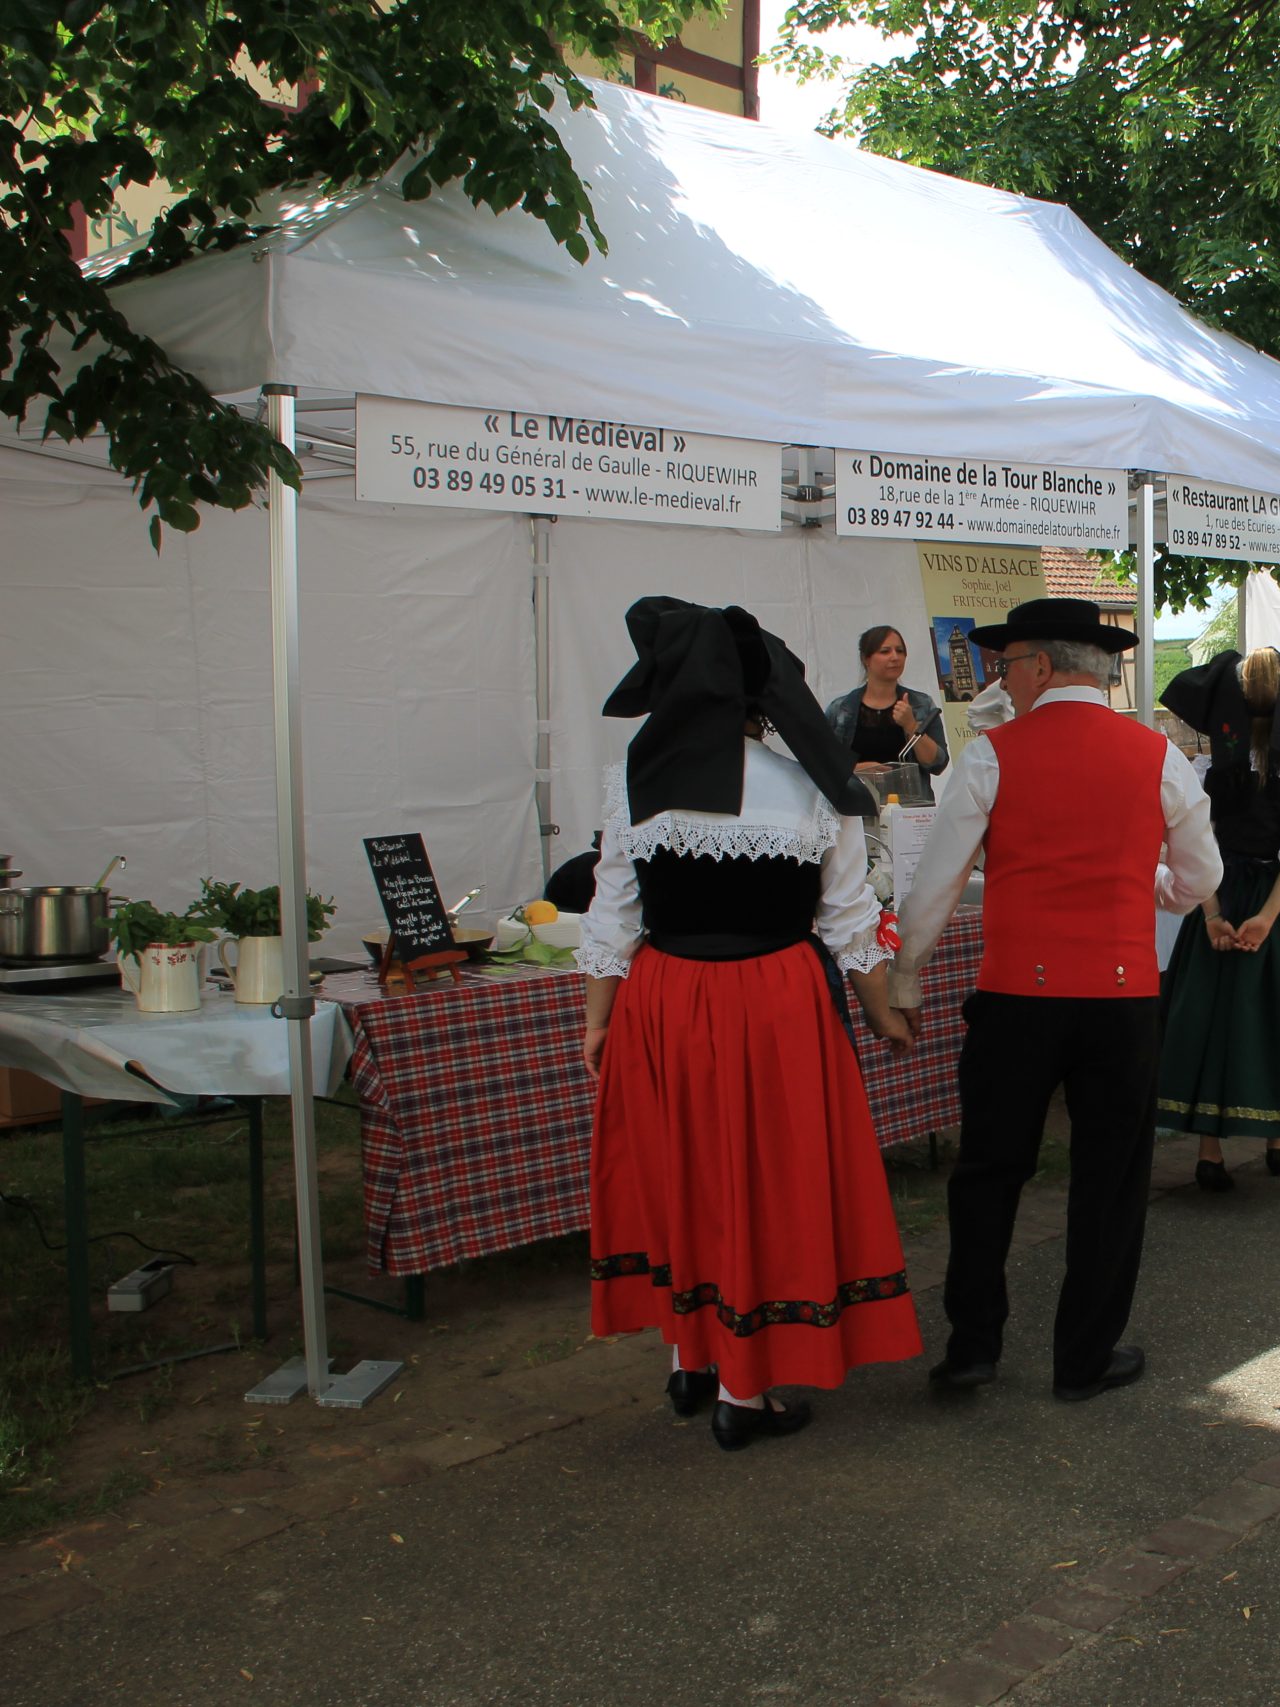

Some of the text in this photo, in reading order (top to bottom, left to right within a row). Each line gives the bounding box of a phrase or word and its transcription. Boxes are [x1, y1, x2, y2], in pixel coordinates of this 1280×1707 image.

[510, 412, 538, 440] Le
[549, 416, 663, 452] Médiéval
[391, 435, 421, 458] 55,
[428, 442, 459, 460] rue
[466, 441, 489, 462] du
[496, 447, 566, 470] Général
[571, 450, 592, 471] de
[599, 455, 650, 477] Gaulle
[666, 467, 758, 487] RIQUEWIHR
[413, 467, 439, 489] 03
[447, 470, 472, 492] 89
[479, 473, 505, 493] 49
[512, 475, 536, 496] 05
[543, 477, 566, 499] 31
[586, 485, 740, 513] www.le-medieval.fr
[870, 456, 950, 483] Domaine
[957, 463, 977, 486] de
[983, 464, 996, 486] la
[1002, 467, 1037, 490] Tour
[1043, 471, 1102, 496] Blanche
[879, 486, 920, 504] 18,rue
[924, 489, 940, 504] de
[944, 490, 954, 505] la
[958, 491, 976, 506] 1ère
[981, 493, 1019, 509] Armée
[1031, 498, 1096, 516] RIQUEWIHR
[1182, 486, 1248, 513] Restaurant
[1252, 495, 1266, 514] LA
[848, 508, 866, 524] 03
[871, 509, 888, 526] 89
[894, 510, 910, 528] 47
[916, 512, 932, 528] 92
[938, 513, 954, 530] 44
[968, 518, 1120, 540] www.domainedelatourblanche.fr
[1206, 514, 1212, 529] 1,
[1215, 518, 1229, 531] rue
[1231, 516, 1245, 531] des
[1248, 519, 1276, 534] Ecuries
[1173, 529, 1185, 545] 03
[1188, 531, 1199, 547] 89
[1202, 532, 1213, 548] 47
[1215, 533, 1227, 549] 89
[1229, 535, 1240, 551] 52
[923, 553, 1039, 576] VINS D'ALSACE
[962, 579, 1011, 593] Sophie, Joël
[953, 595, 1022, 608] FRITSCH & Fil
[955, 728, 976, 738] Vins
